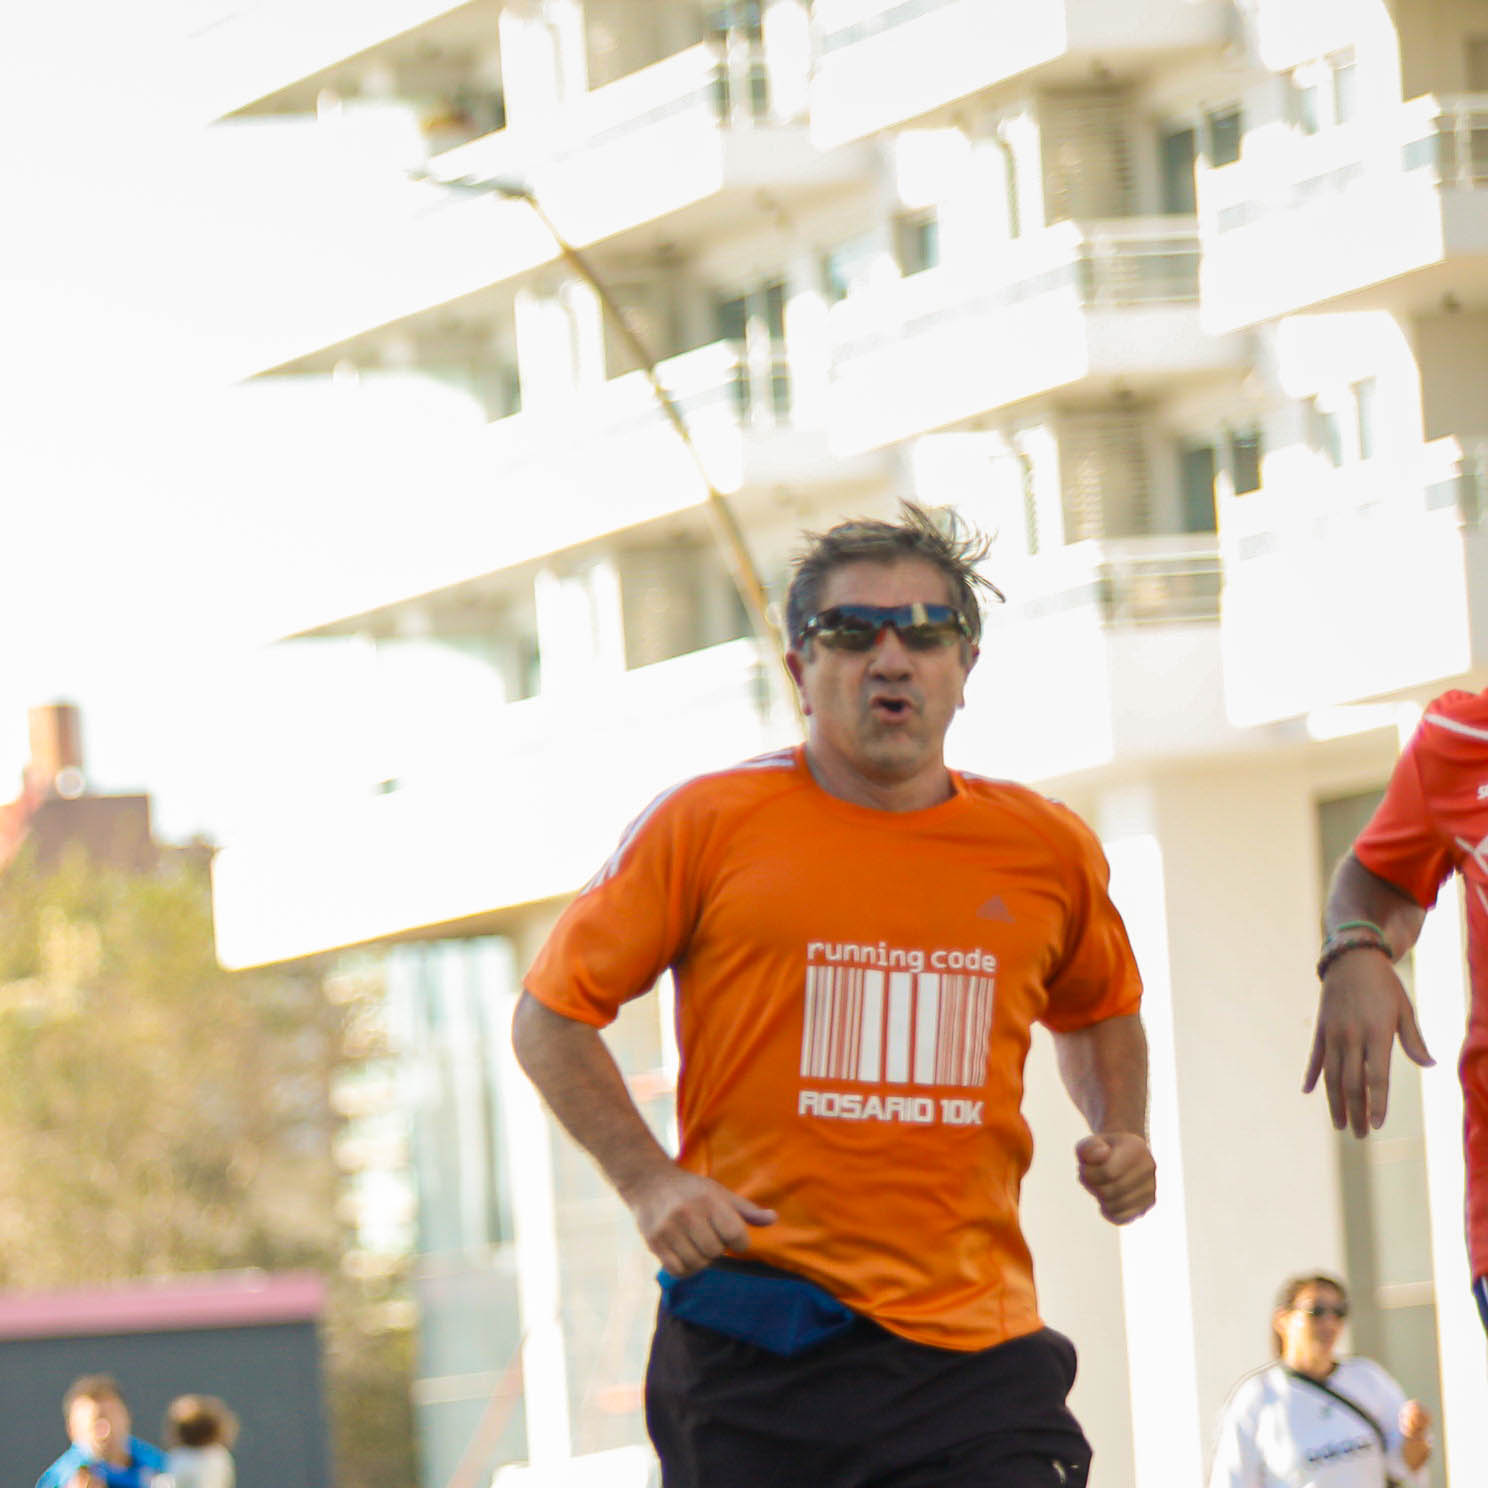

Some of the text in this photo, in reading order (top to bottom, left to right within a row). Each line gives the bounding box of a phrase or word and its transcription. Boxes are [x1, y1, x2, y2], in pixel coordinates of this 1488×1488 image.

[807, 941, 997, 973] running code
[798, 1090, 984, 1125] ROSARIO 10K
